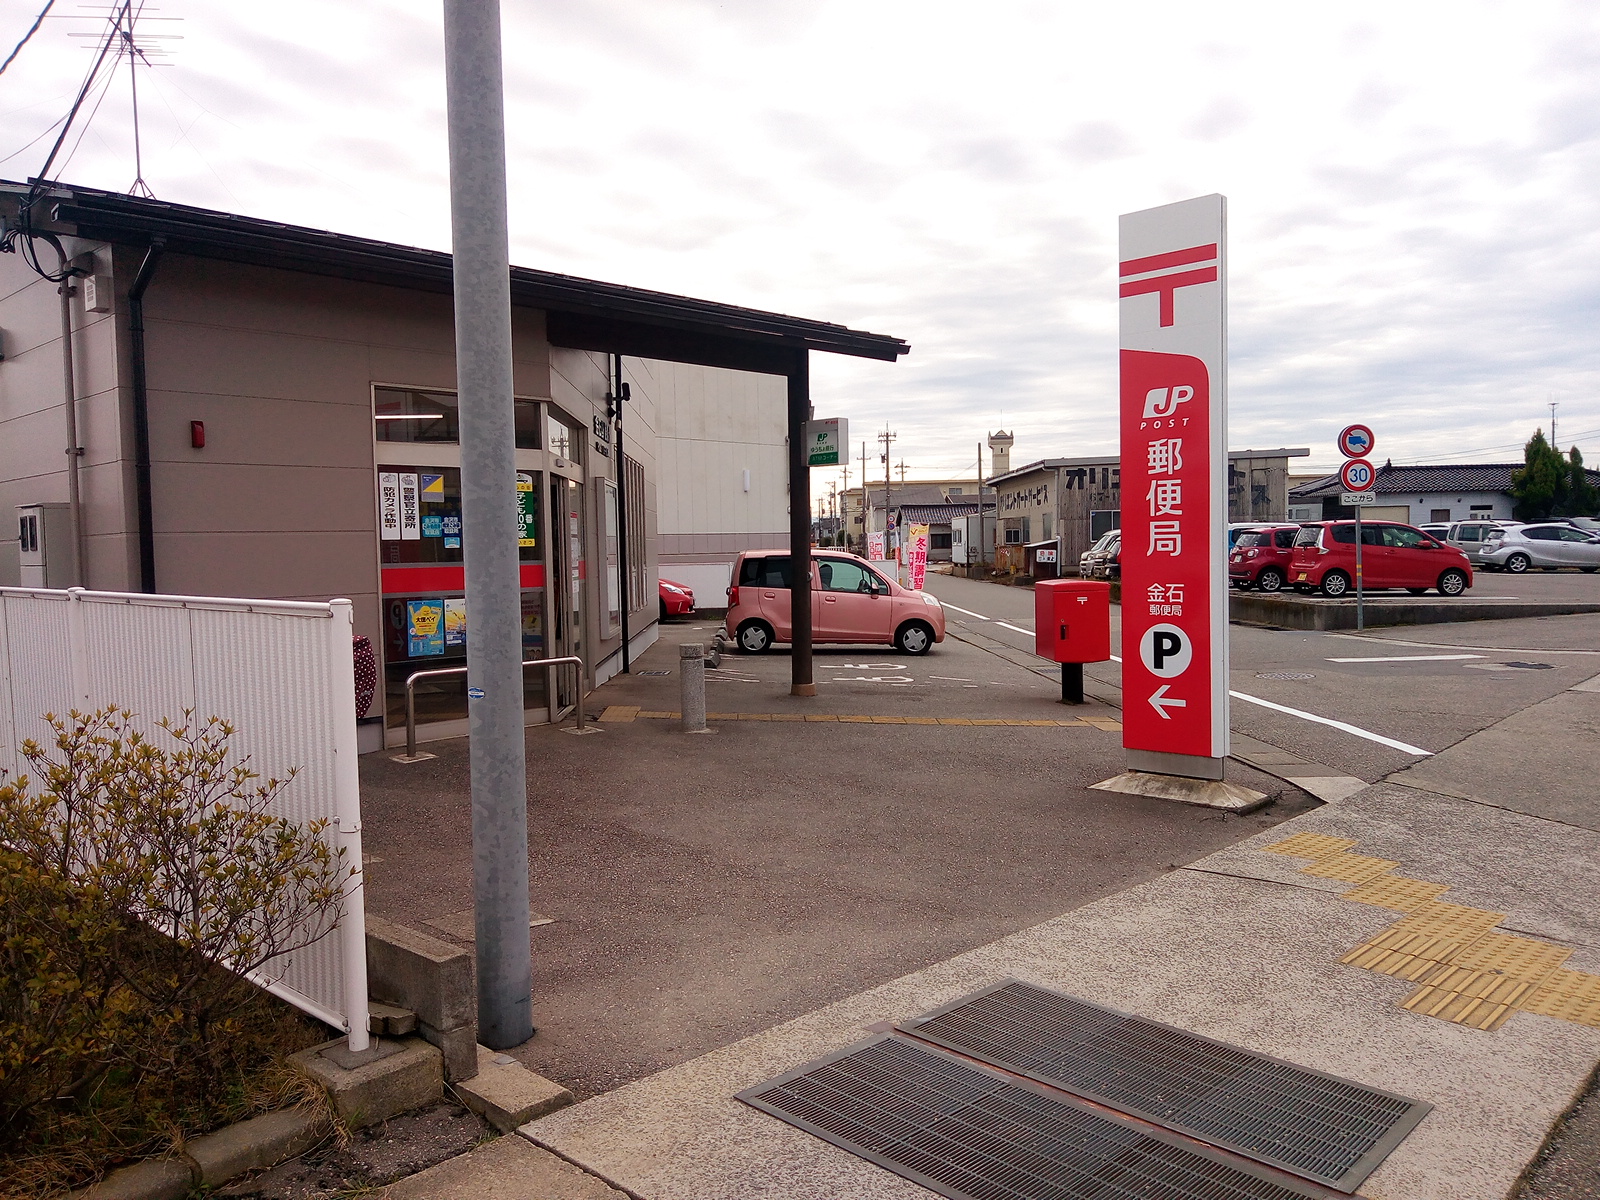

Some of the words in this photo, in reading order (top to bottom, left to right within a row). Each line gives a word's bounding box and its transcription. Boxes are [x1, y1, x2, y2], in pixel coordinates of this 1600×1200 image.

[1142, 385, 1194, 418] JP
[1140, 418, 1189, 430] POST
[1349, 468, 1368, 483] 30
[383, 486, 397, 529] 防犯カメラ作動中
[403, 487, 416, 529] 警察官立寄所
[1145, 438, 1183, 557] 郵便局
[1343, 494, 1374, 503] ここから
[1147, 583, 1185, 603] 金石
[1149, 604, 1182, 616] 郵便局
[1153, 631, 1182, 669] P
